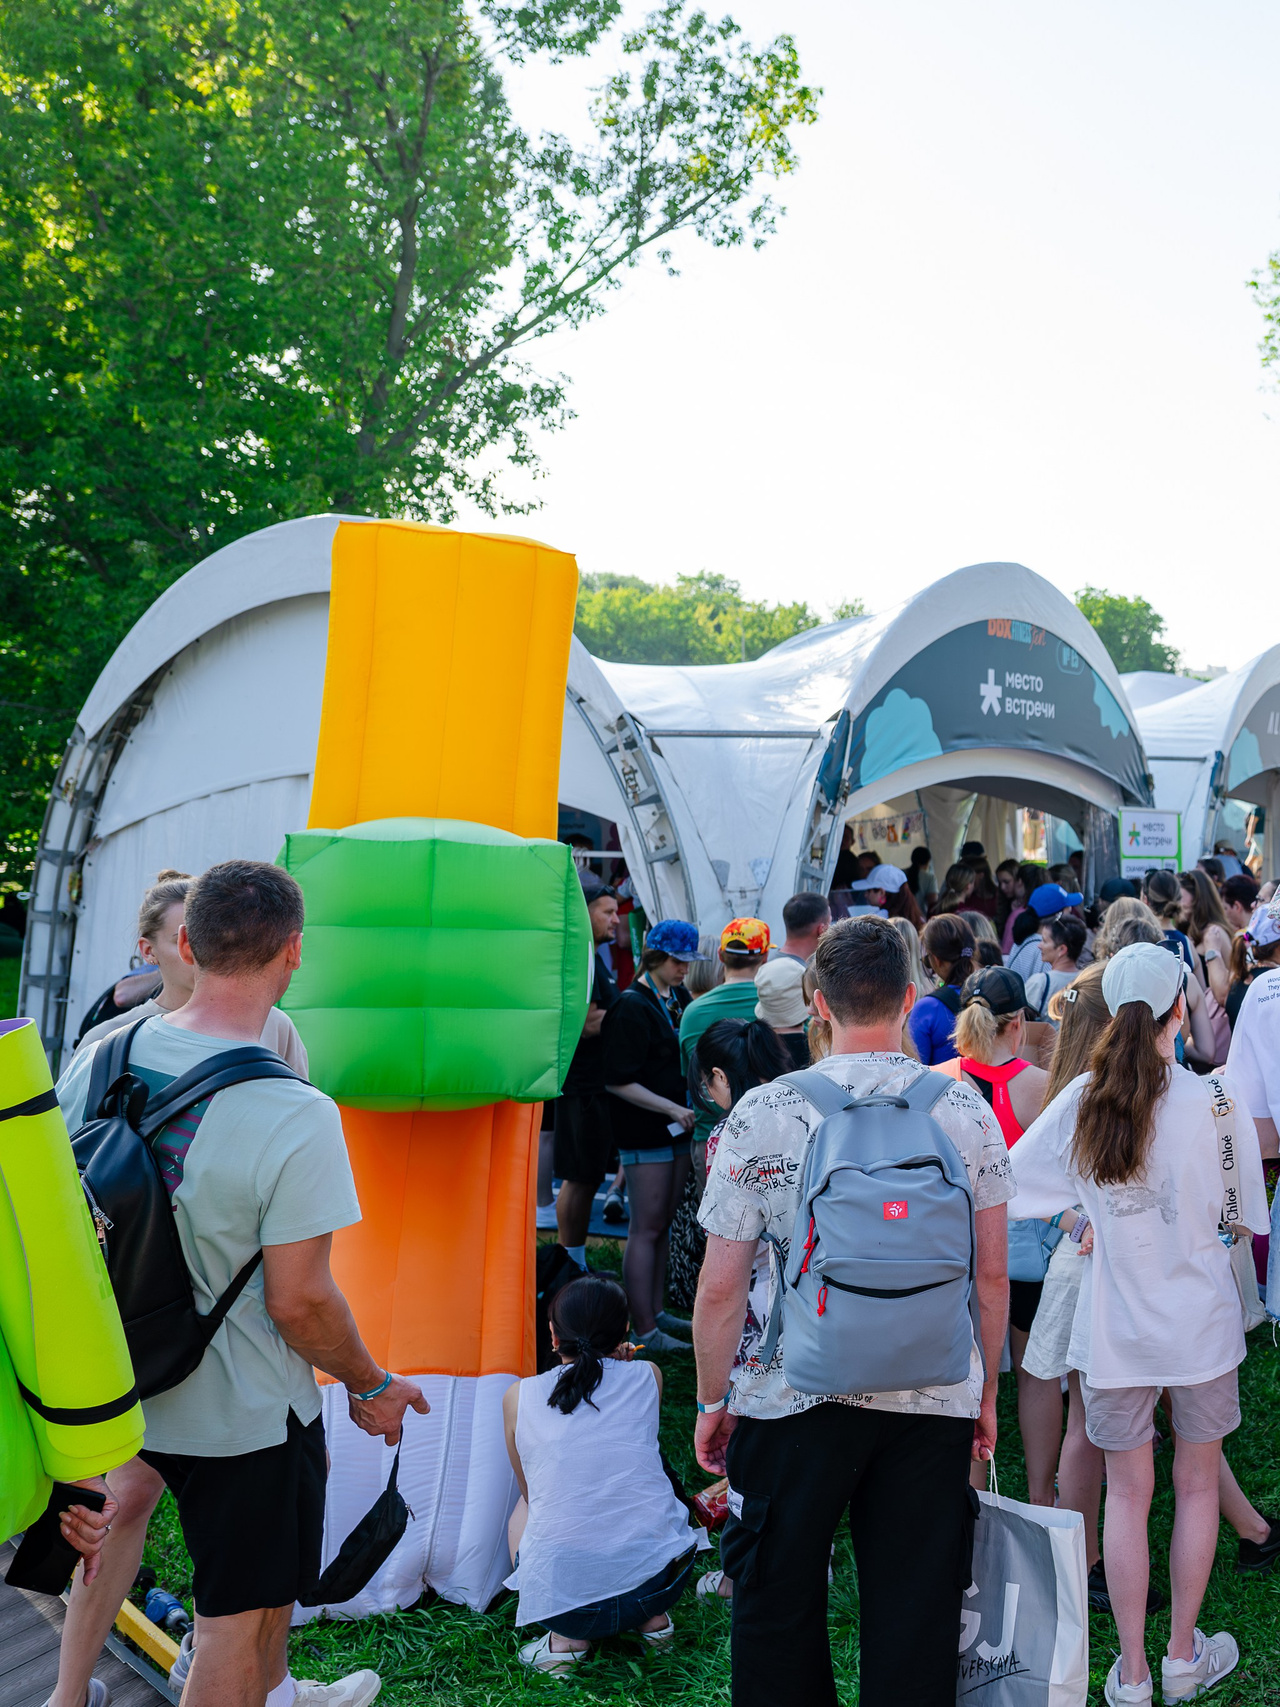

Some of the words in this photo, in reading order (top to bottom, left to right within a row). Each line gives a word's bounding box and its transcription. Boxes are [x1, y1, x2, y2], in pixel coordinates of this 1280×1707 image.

[1005, 672, 1044, 692] место
[1005, 697, 1055, 720] встречи
[1208, 1078, 1229, 1117] Chloé
[1222, 1134, 1234, 1170] Chloé
[1226, 1187, 1238, 1222] Chloé
